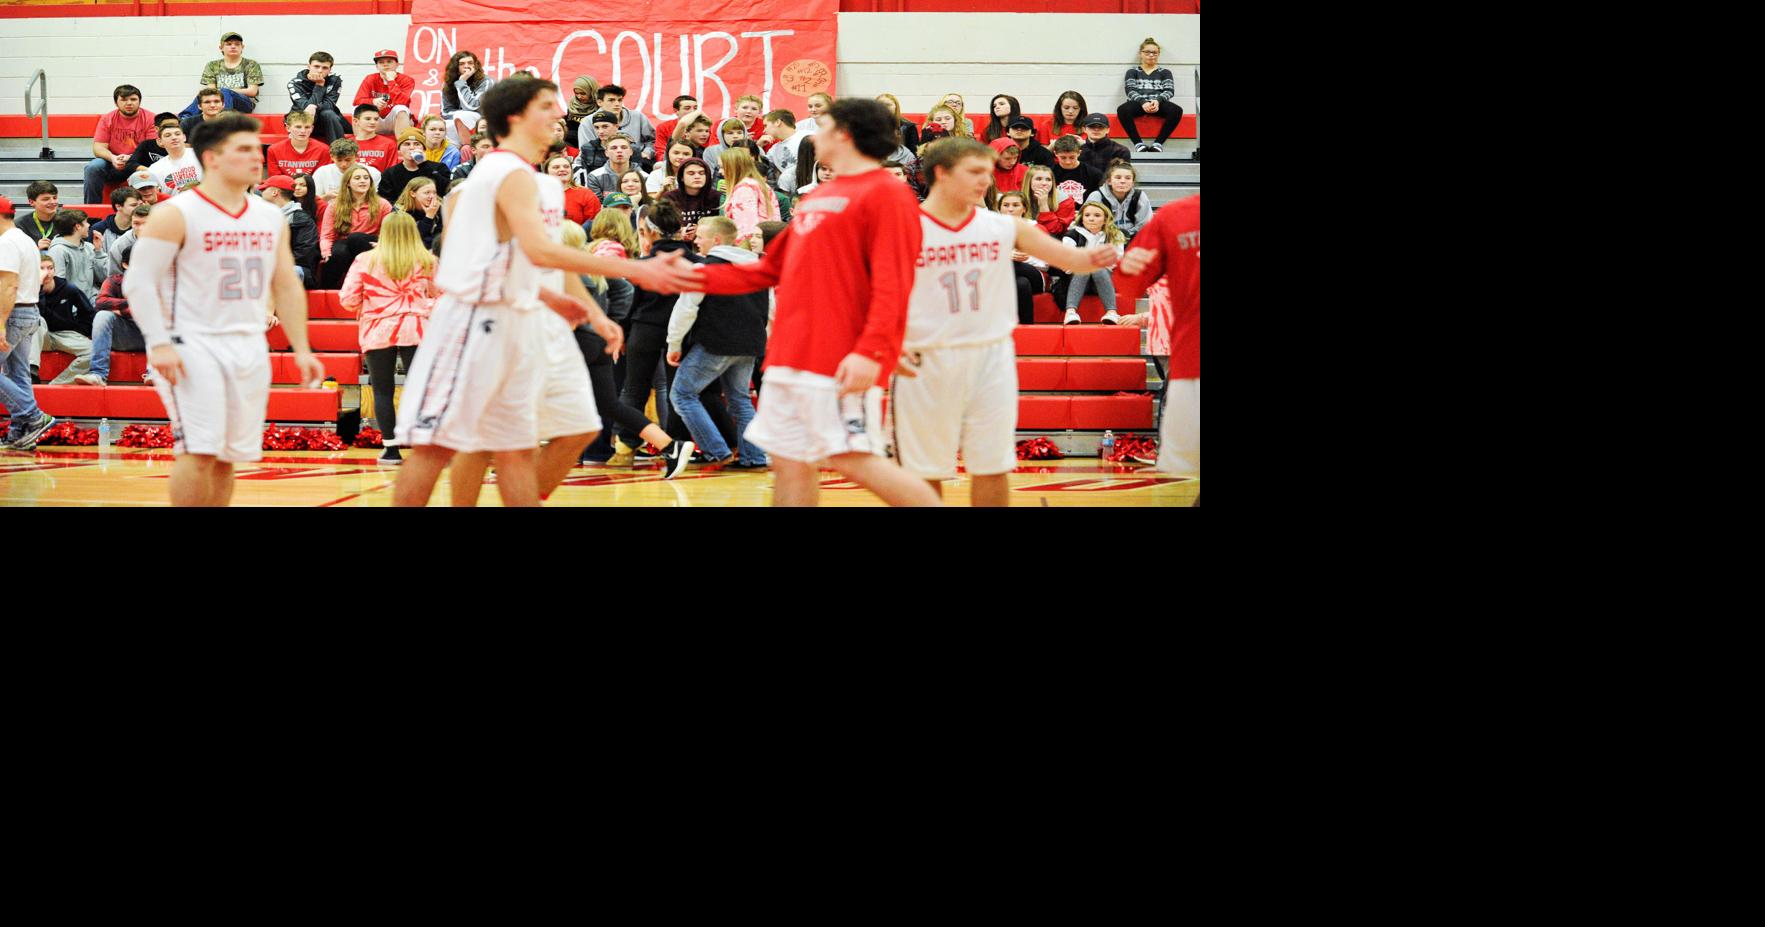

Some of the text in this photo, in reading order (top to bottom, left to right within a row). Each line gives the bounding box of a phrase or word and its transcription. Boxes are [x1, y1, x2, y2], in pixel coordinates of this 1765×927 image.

[413, 26, 456, 64] ON
[422, 68, 438, 87] &
[551, 29, 795, 121] COURT
[204, 231, 273, 253] SPARTANS
[915, 241, 999, 267] SPARTANS
[218, 256, 264, 300] 20
[939, 269, 981, 313] 11
